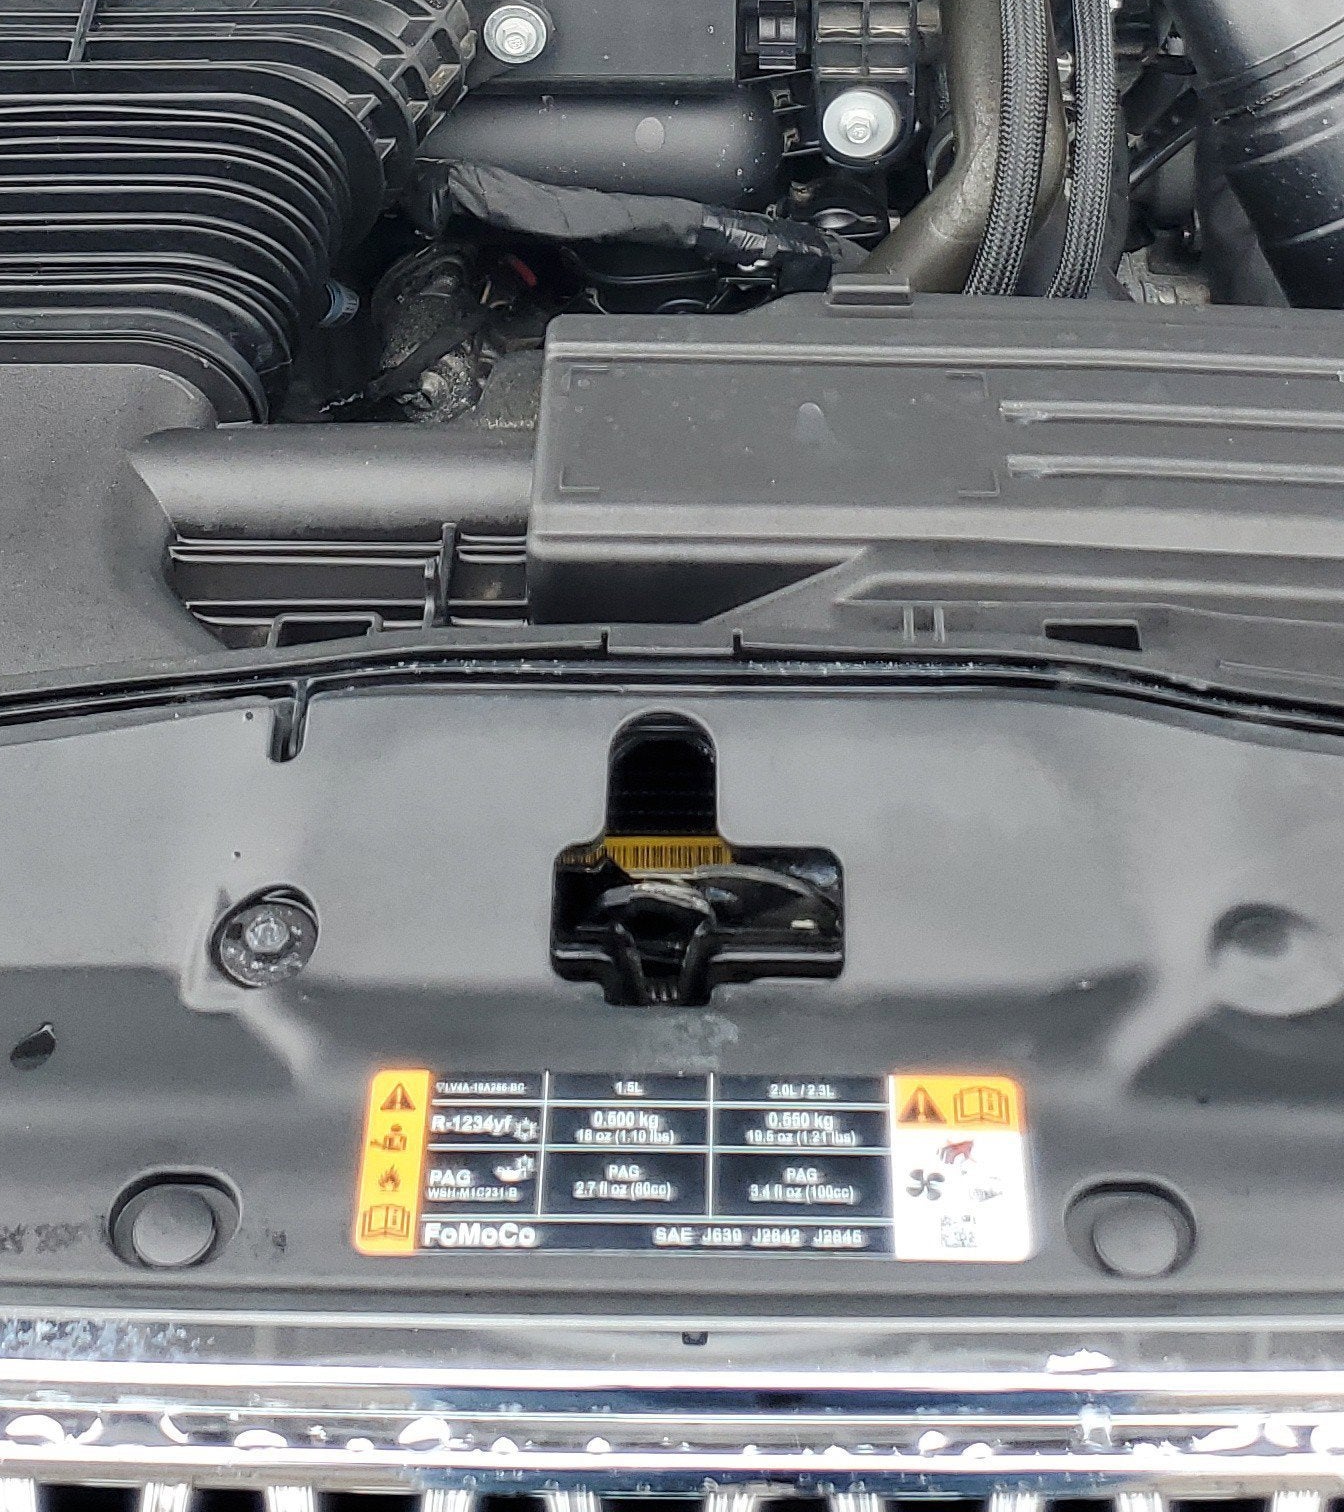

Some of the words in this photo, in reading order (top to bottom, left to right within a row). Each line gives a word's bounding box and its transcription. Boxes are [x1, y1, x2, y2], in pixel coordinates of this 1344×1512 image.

[431, 1114, 513, 1135] R-1234yf
[639, 1110, 659, 1130] kg
[814, 1111, 834, 1132] kg
[429, 1169, 472, 1186] PAG
[608, 1164, 641, 1180] PAG
[785, 1167, 819, 1183] PAG
[424, 1222, 537, 1246] FoMoCo
[655, 1227, 693, 1244] SAE
